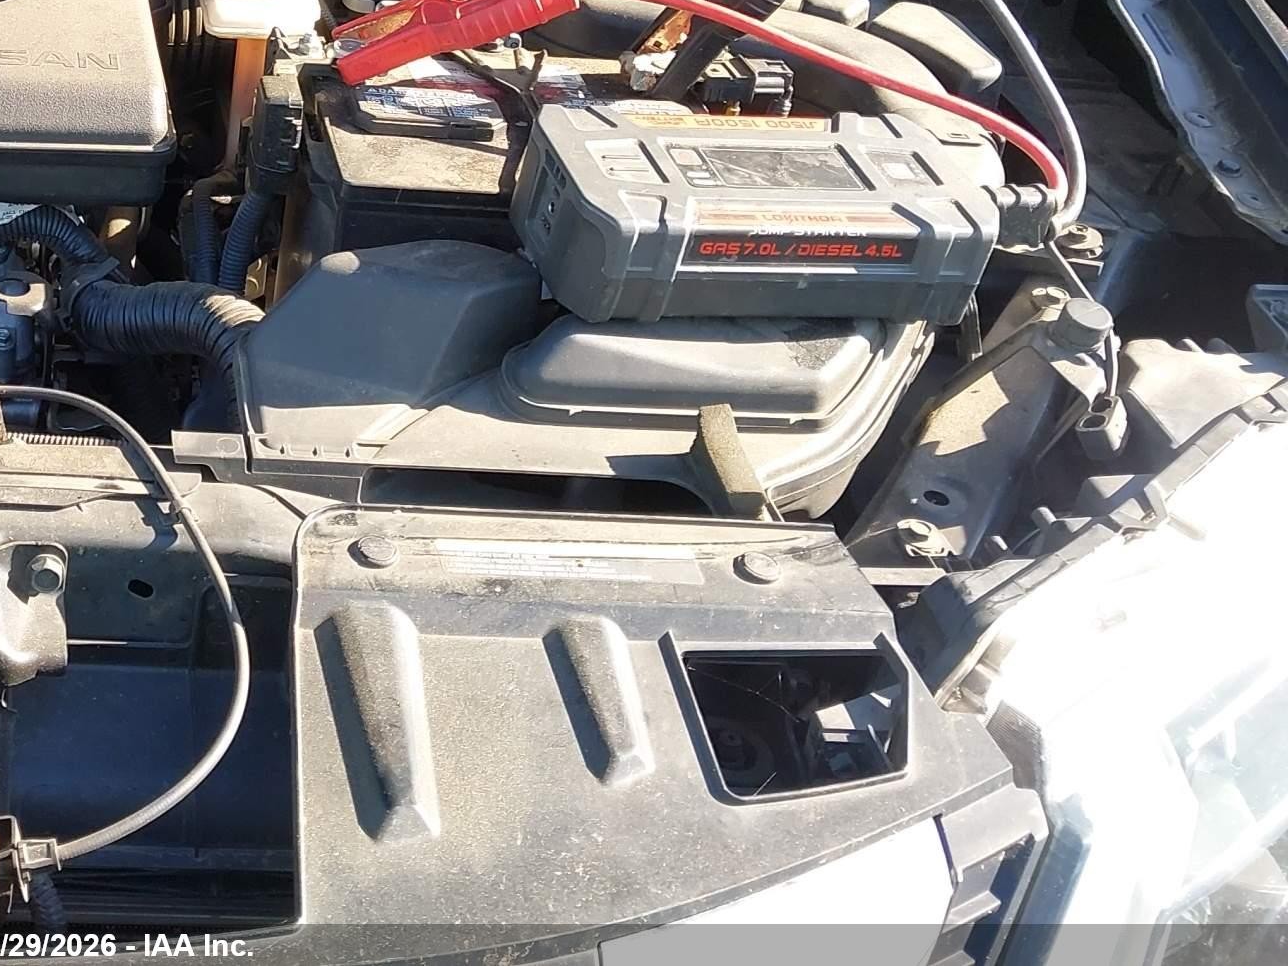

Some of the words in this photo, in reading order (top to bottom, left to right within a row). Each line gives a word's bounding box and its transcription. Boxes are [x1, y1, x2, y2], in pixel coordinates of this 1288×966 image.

[695, 117, 758, 129] 1500A
[698, 241, 741, 256] GAS
[743, 242, 782, 256] 7.0L
[784, 243, 797, 256] /
[796, 243, 863, 257] DIESEL
